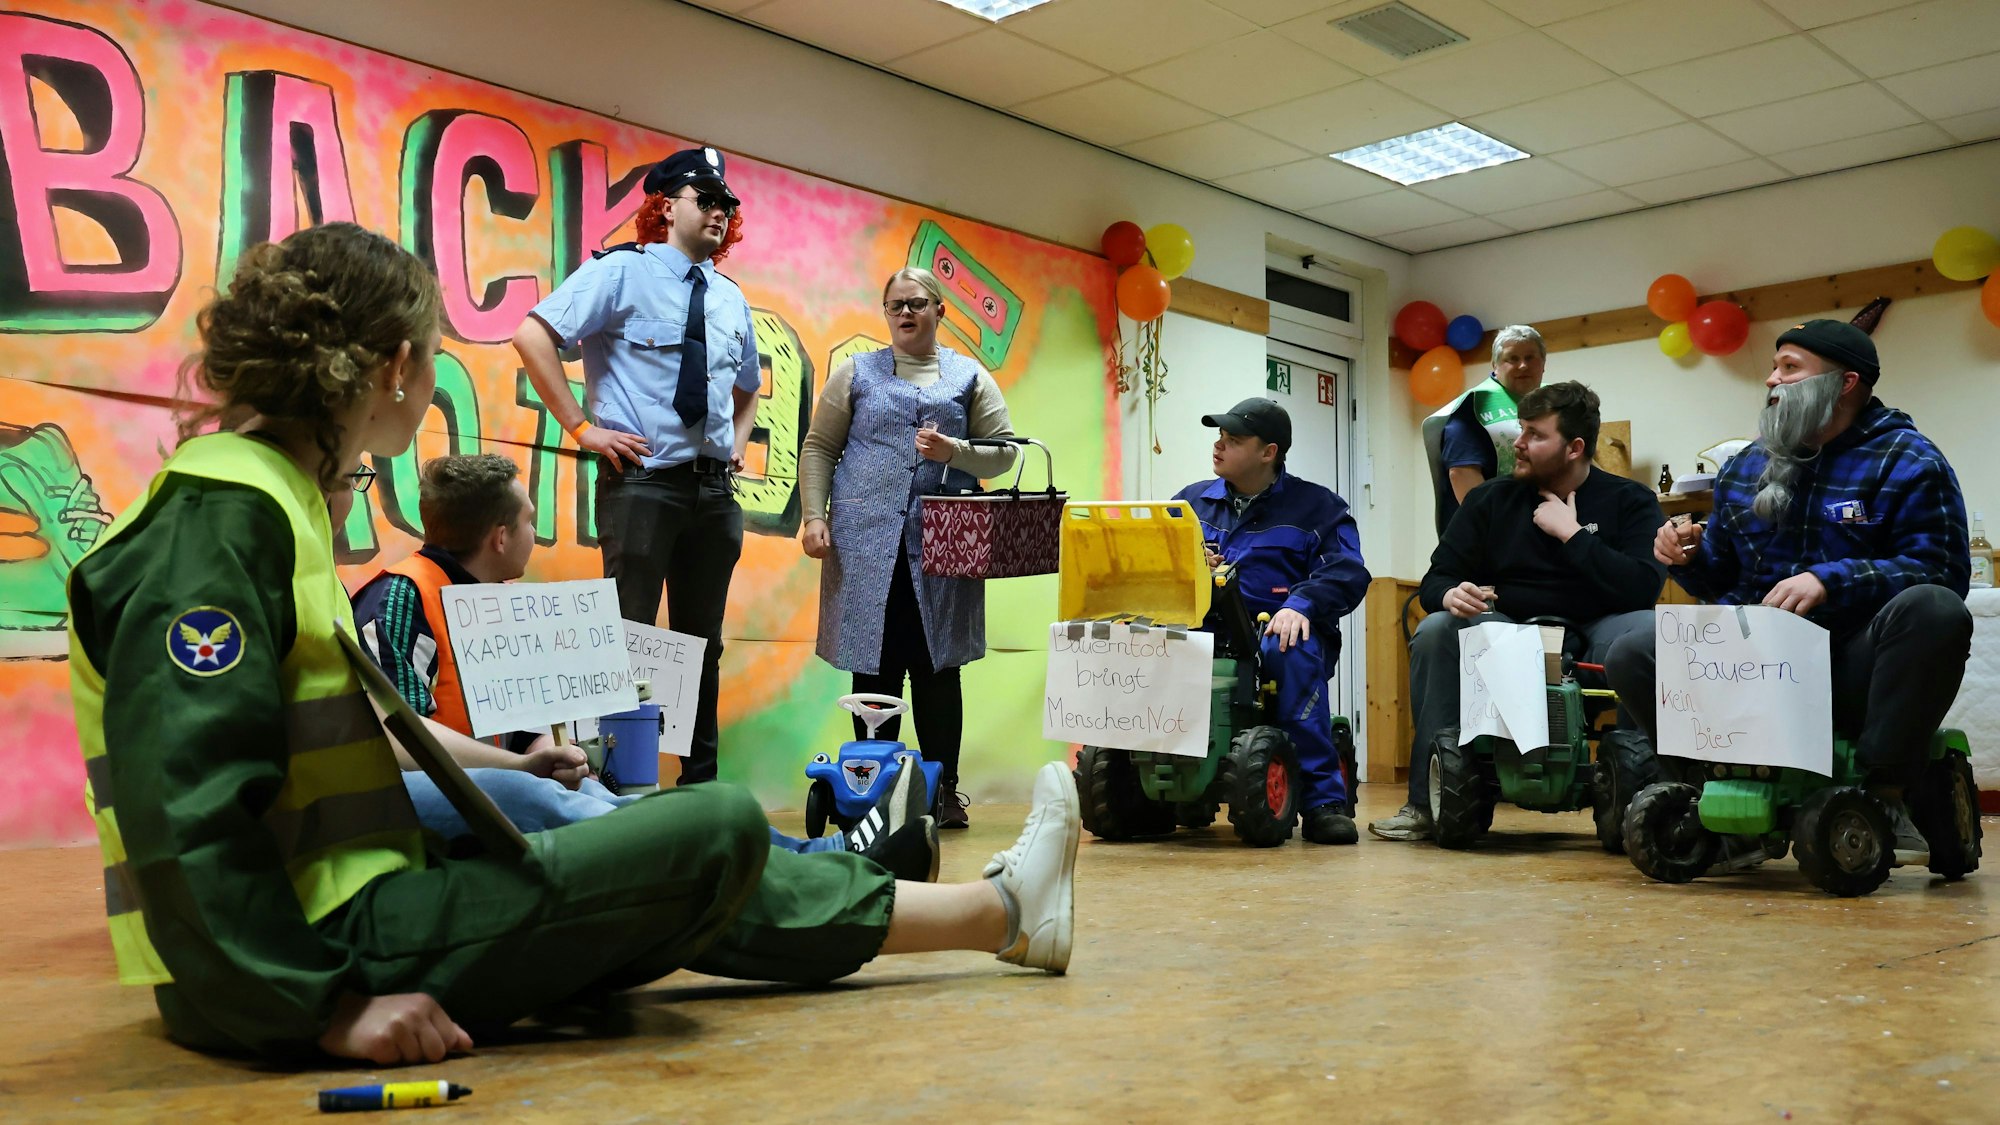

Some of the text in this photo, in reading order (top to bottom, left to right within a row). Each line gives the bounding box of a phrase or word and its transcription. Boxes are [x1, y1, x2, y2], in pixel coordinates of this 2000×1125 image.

[511, 595, 562, 622] ERDE
[573, 590, 599, 615] IST
[461, 625, 616, 664] KAPUTA ALS DIE
[1052, 624, 1171, 658] Bauerntod
[1660, 611, 1726, 645] Ohne
[1076, 660, 1150, 694] bringt
[1684, 646, 1800, 684] Bauern
[472, 675, 554, 713] HÜFFTE
[1691, 717, 1748, 751] Bier
